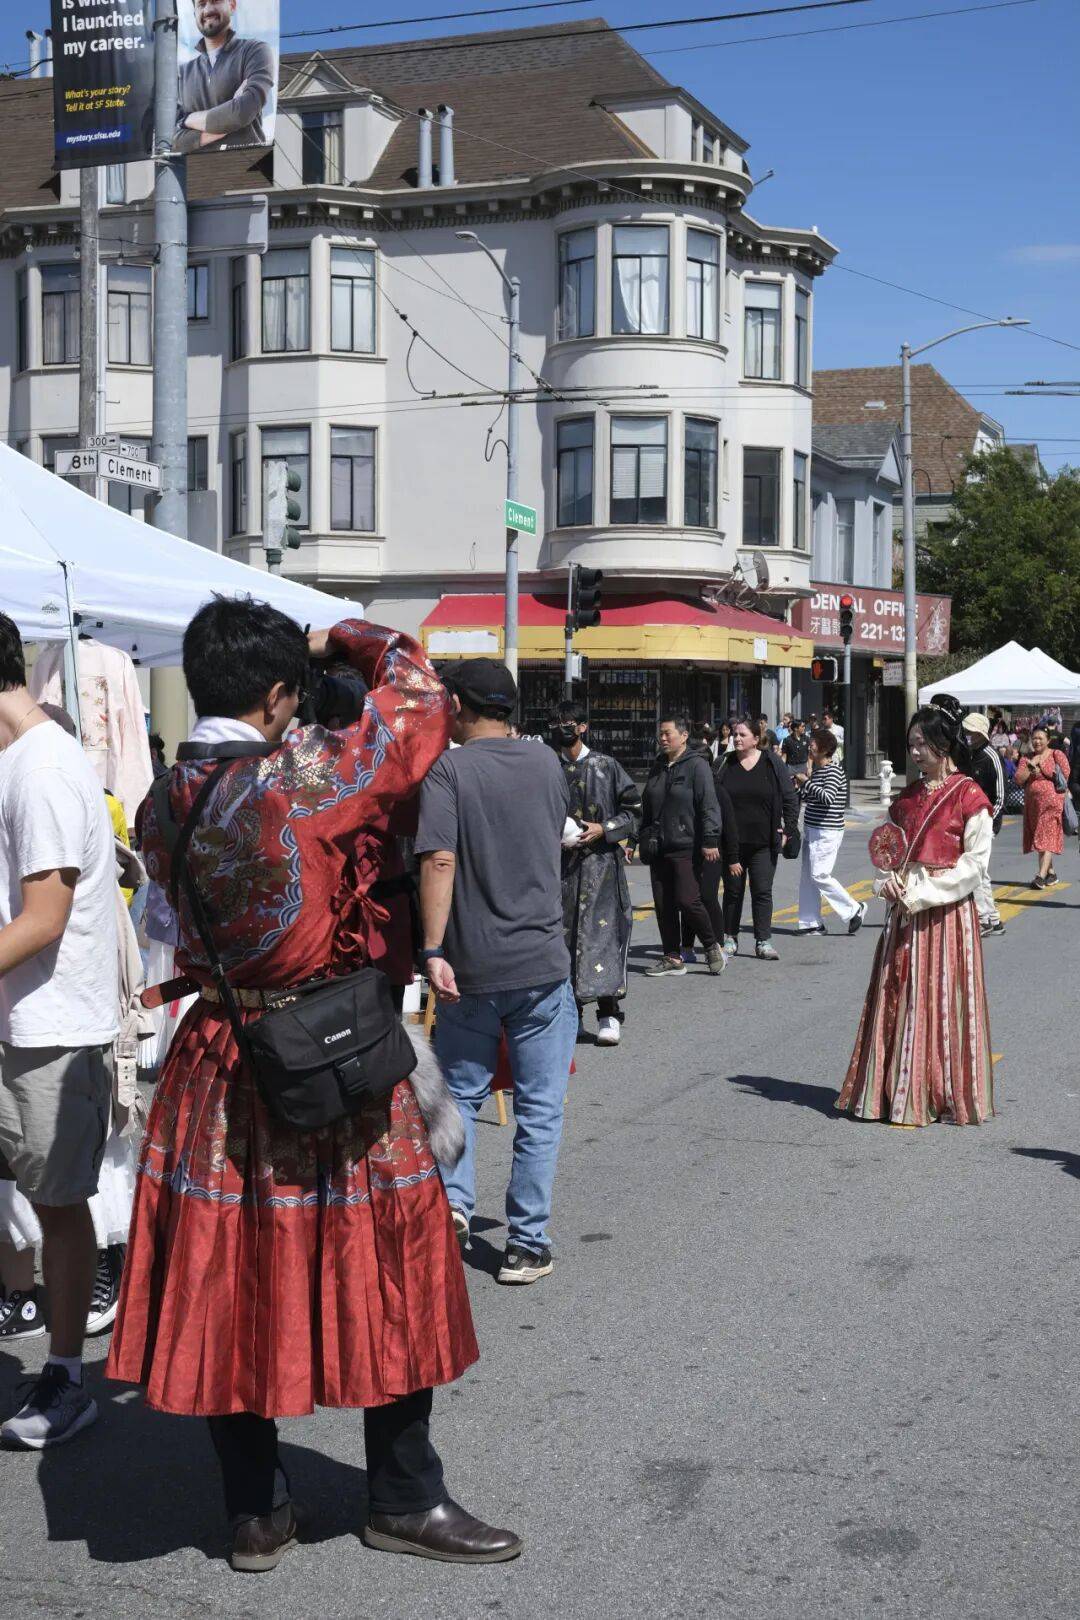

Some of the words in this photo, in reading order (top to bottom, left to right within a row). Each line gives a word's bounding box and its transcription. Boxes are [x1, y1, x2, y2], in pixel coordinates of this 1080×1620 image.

[62, 16, 68, 32] I
[71, 9, 144, 31] launched
[63, 40, 87, 58] my
[90, 36, 145, 52] career.
[65, 89, 89, 99] What's
[90, 88, 107, 98] your
[108, 85, 131, 95] story?
[65, 103, 78, 112] Tell
[79, 102, 84, 111] it
[85, 102, 94, 110] at
[95, 100, 104, 109] SF
[105, 99, 126, 108] State.
[66, 130, 121, 144] mystory.sfsu.edu
[90, 437, 107, 447] 300
[127, 445, 139, 457] 700
[72, 455, 95, 469] 8th
[108, 459, 152, 482] Clement
[508, 507, 534, 528] Clement
[810, 593, 866, 613] DENAL
[873, 599, 918, 619] OFFI
[861, 622, 918, 641] 221-13
[324, 1028, 352, 1044] Canon
